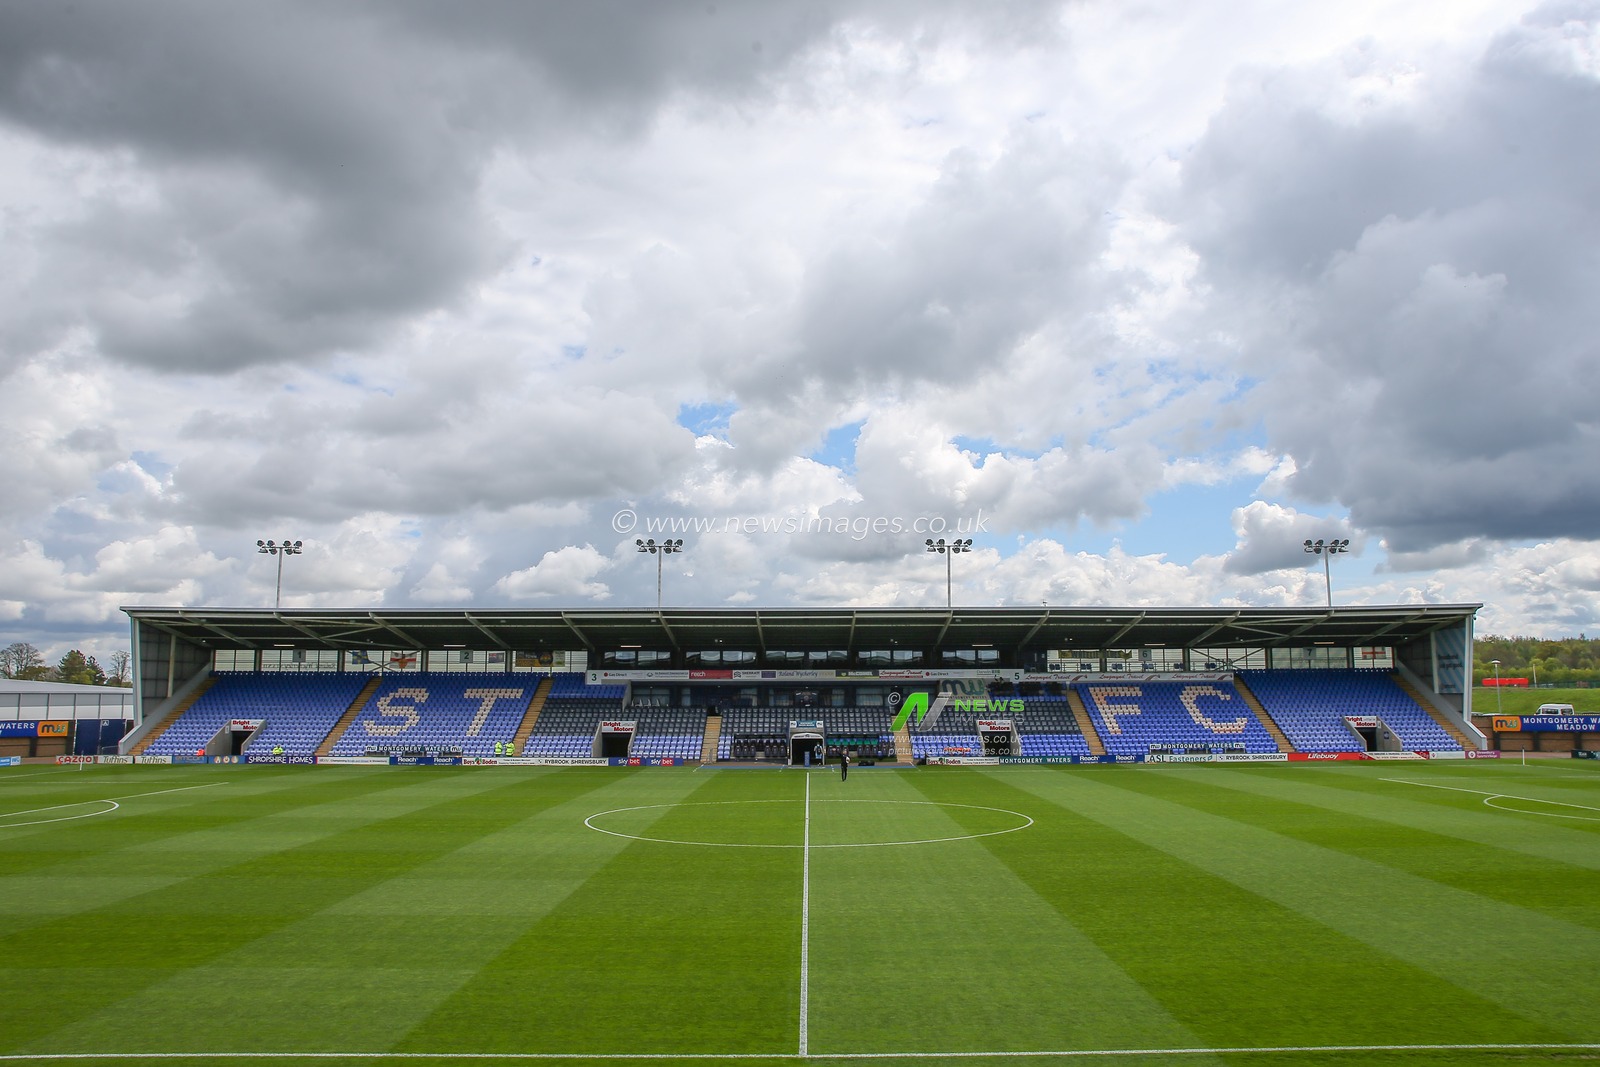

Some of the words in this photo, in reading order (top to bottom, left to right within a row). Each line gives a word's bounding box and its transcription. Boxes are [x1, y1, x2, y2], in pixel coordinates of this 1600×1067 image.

[591, 673, 597, 681] 3
[464, 688, 524, 736] T
[1089, 687, 1143, 734] F
[1180, 686, 1248, 733] C
[289, 756, 313, 764] HOMES
[618, 758, 628, 766] sky
[651, 758, 661, 766] sky
[1149, 754, 1167, 762] ASL
